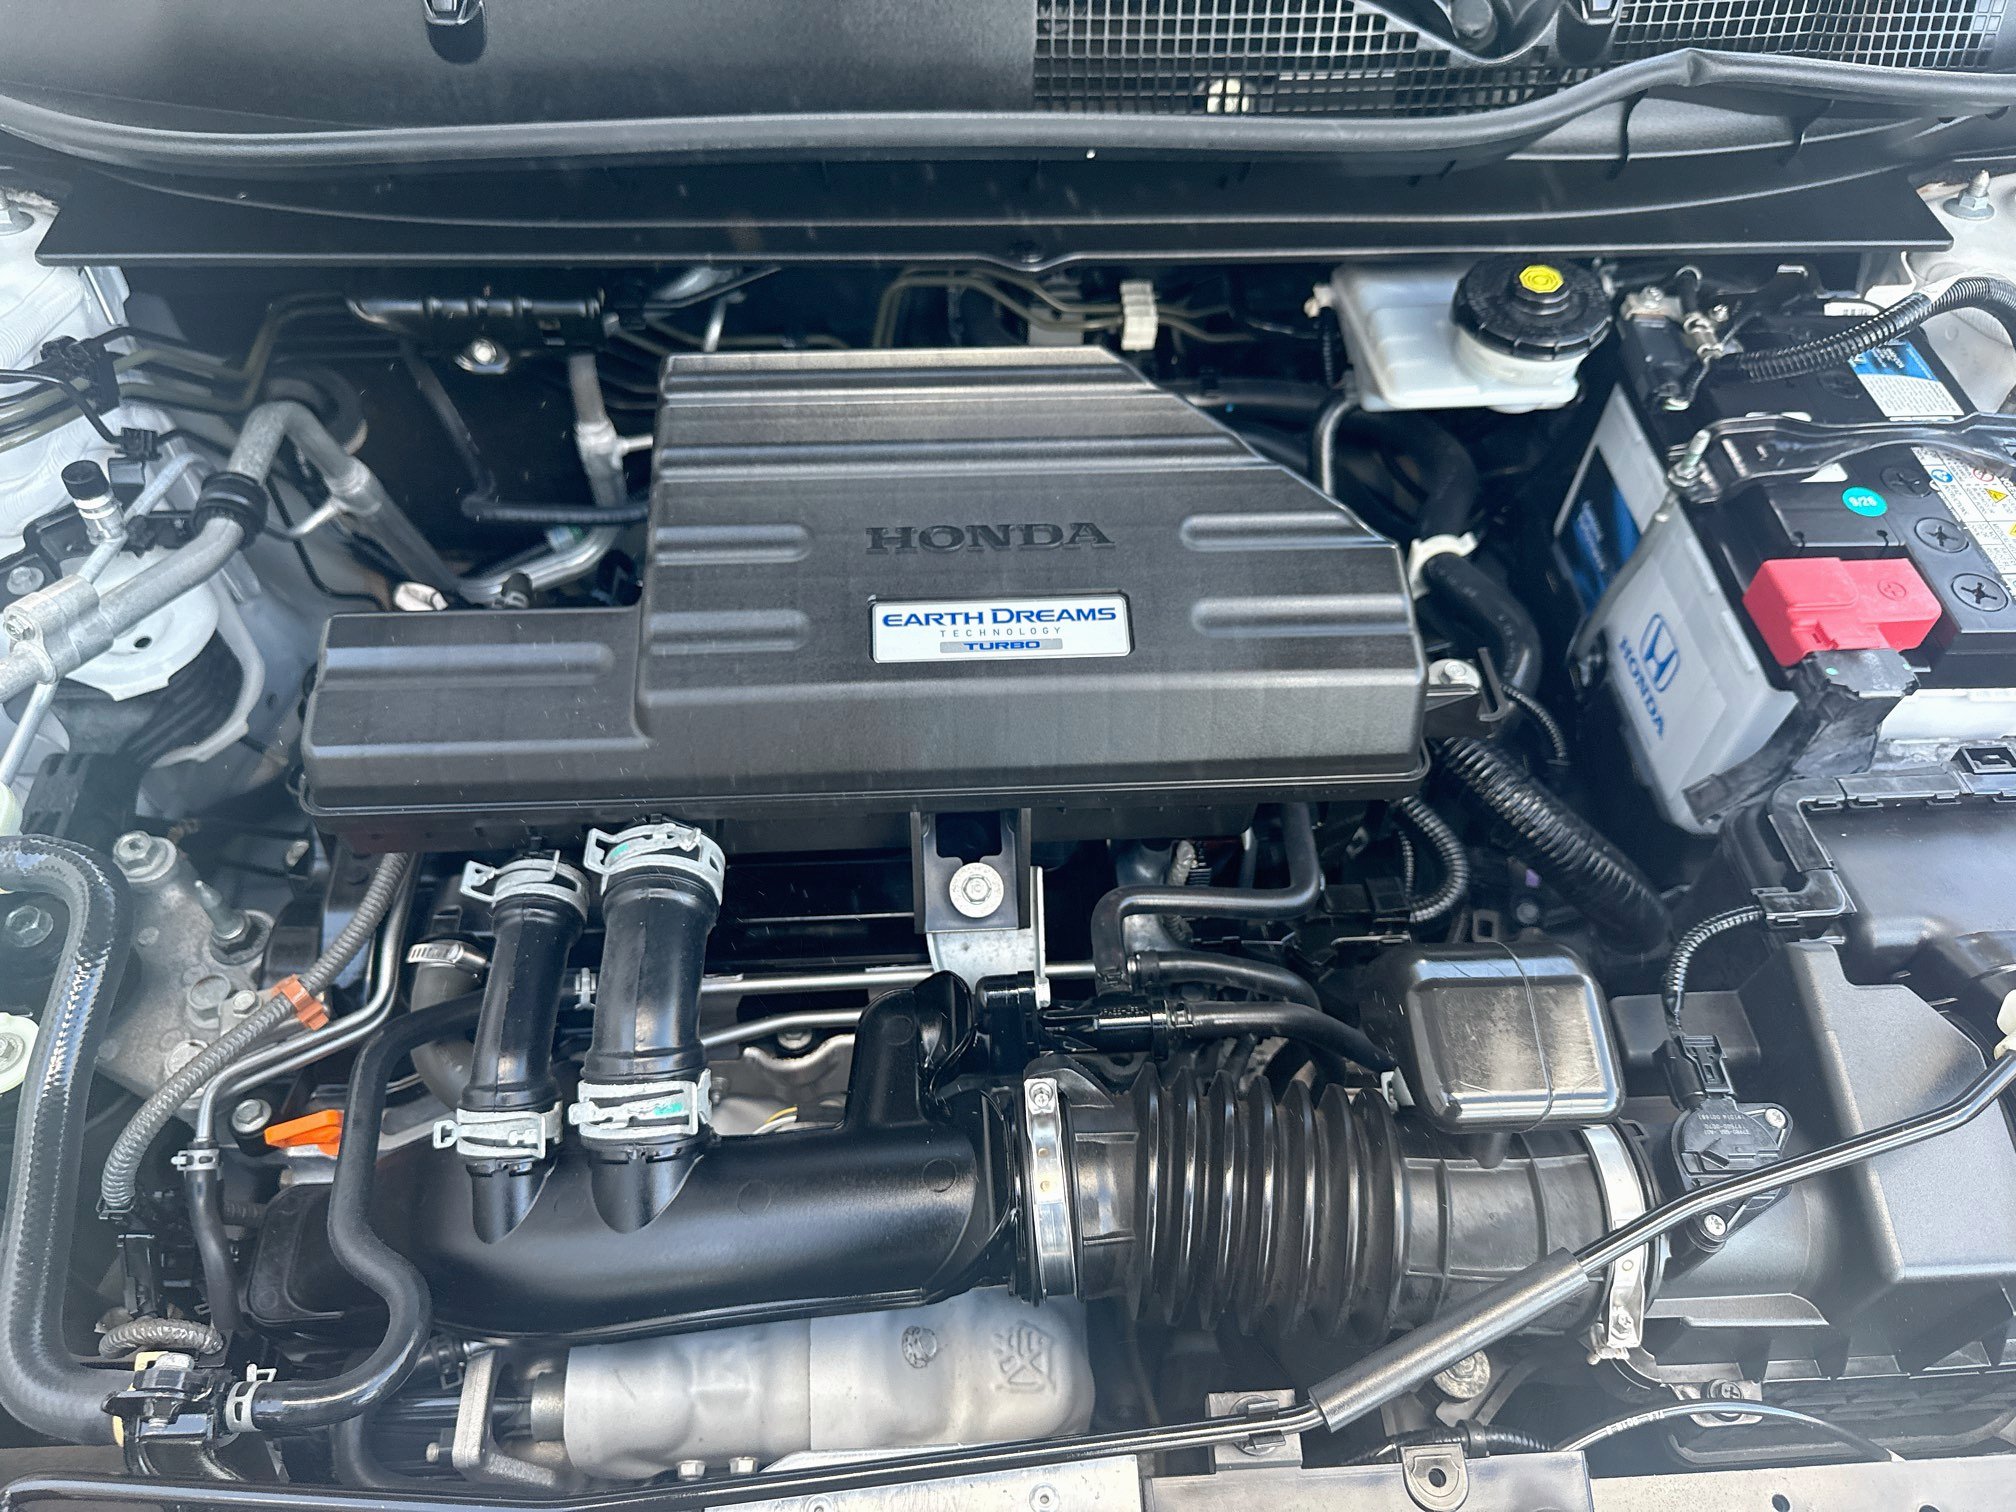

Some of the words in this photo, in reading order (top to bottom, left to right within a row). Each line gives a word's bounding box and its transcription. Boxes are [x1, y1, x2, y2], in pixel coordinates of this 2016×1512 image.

[866, 522, 1115, 553] HONDA
[882, 611, 983, 627] EARTH
[991, 607, 1117, 625] DREAMS
[939, 626, 1061, 638] TECHNOLOGY
[963, 640, 1041, 651] TURBO
[1619, 637, 1664, 739] HONDA
